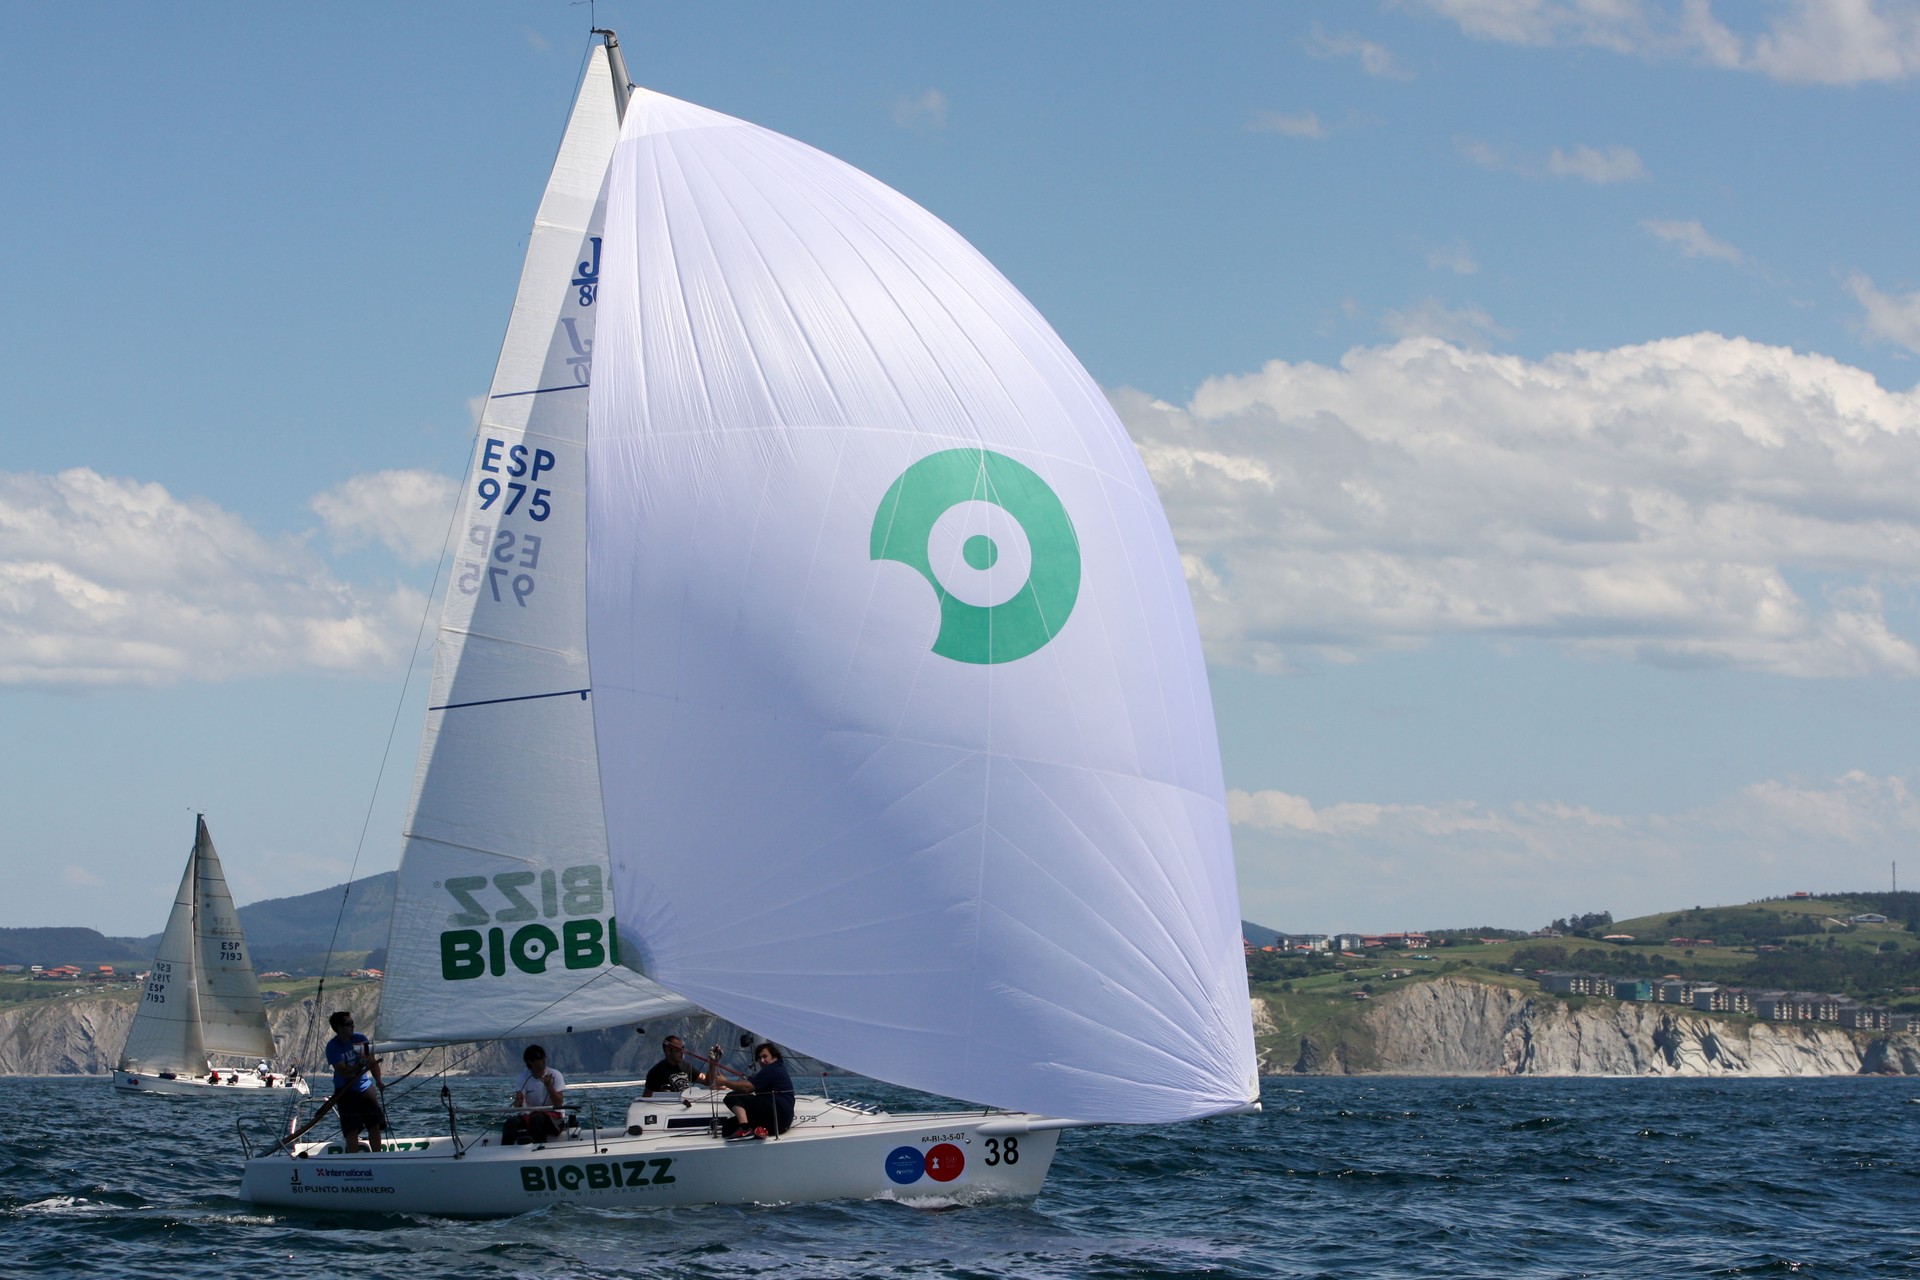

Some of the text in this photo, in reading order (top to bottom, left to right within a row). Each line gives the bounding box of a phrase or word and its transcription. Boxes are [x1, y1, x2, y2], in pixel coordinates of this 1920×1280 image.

[481, 438, 556, 481] ESP
[478, 478, 551, 522] 975
[221, 941, 241, 950] ESP
[219, 951, 242, 961] 7193
[149, 983, 165, 992] ESP
[146, 993, 165, 1003] 7193
[984, 1136, 1020, 1167] 38
[290, 1168, 299, 1183] J
[325, 1168, 373, 1177] International
[292, 1186, 303, 1194] 80
[304, 1185, 396, 1194] PUNTO MARINERO
